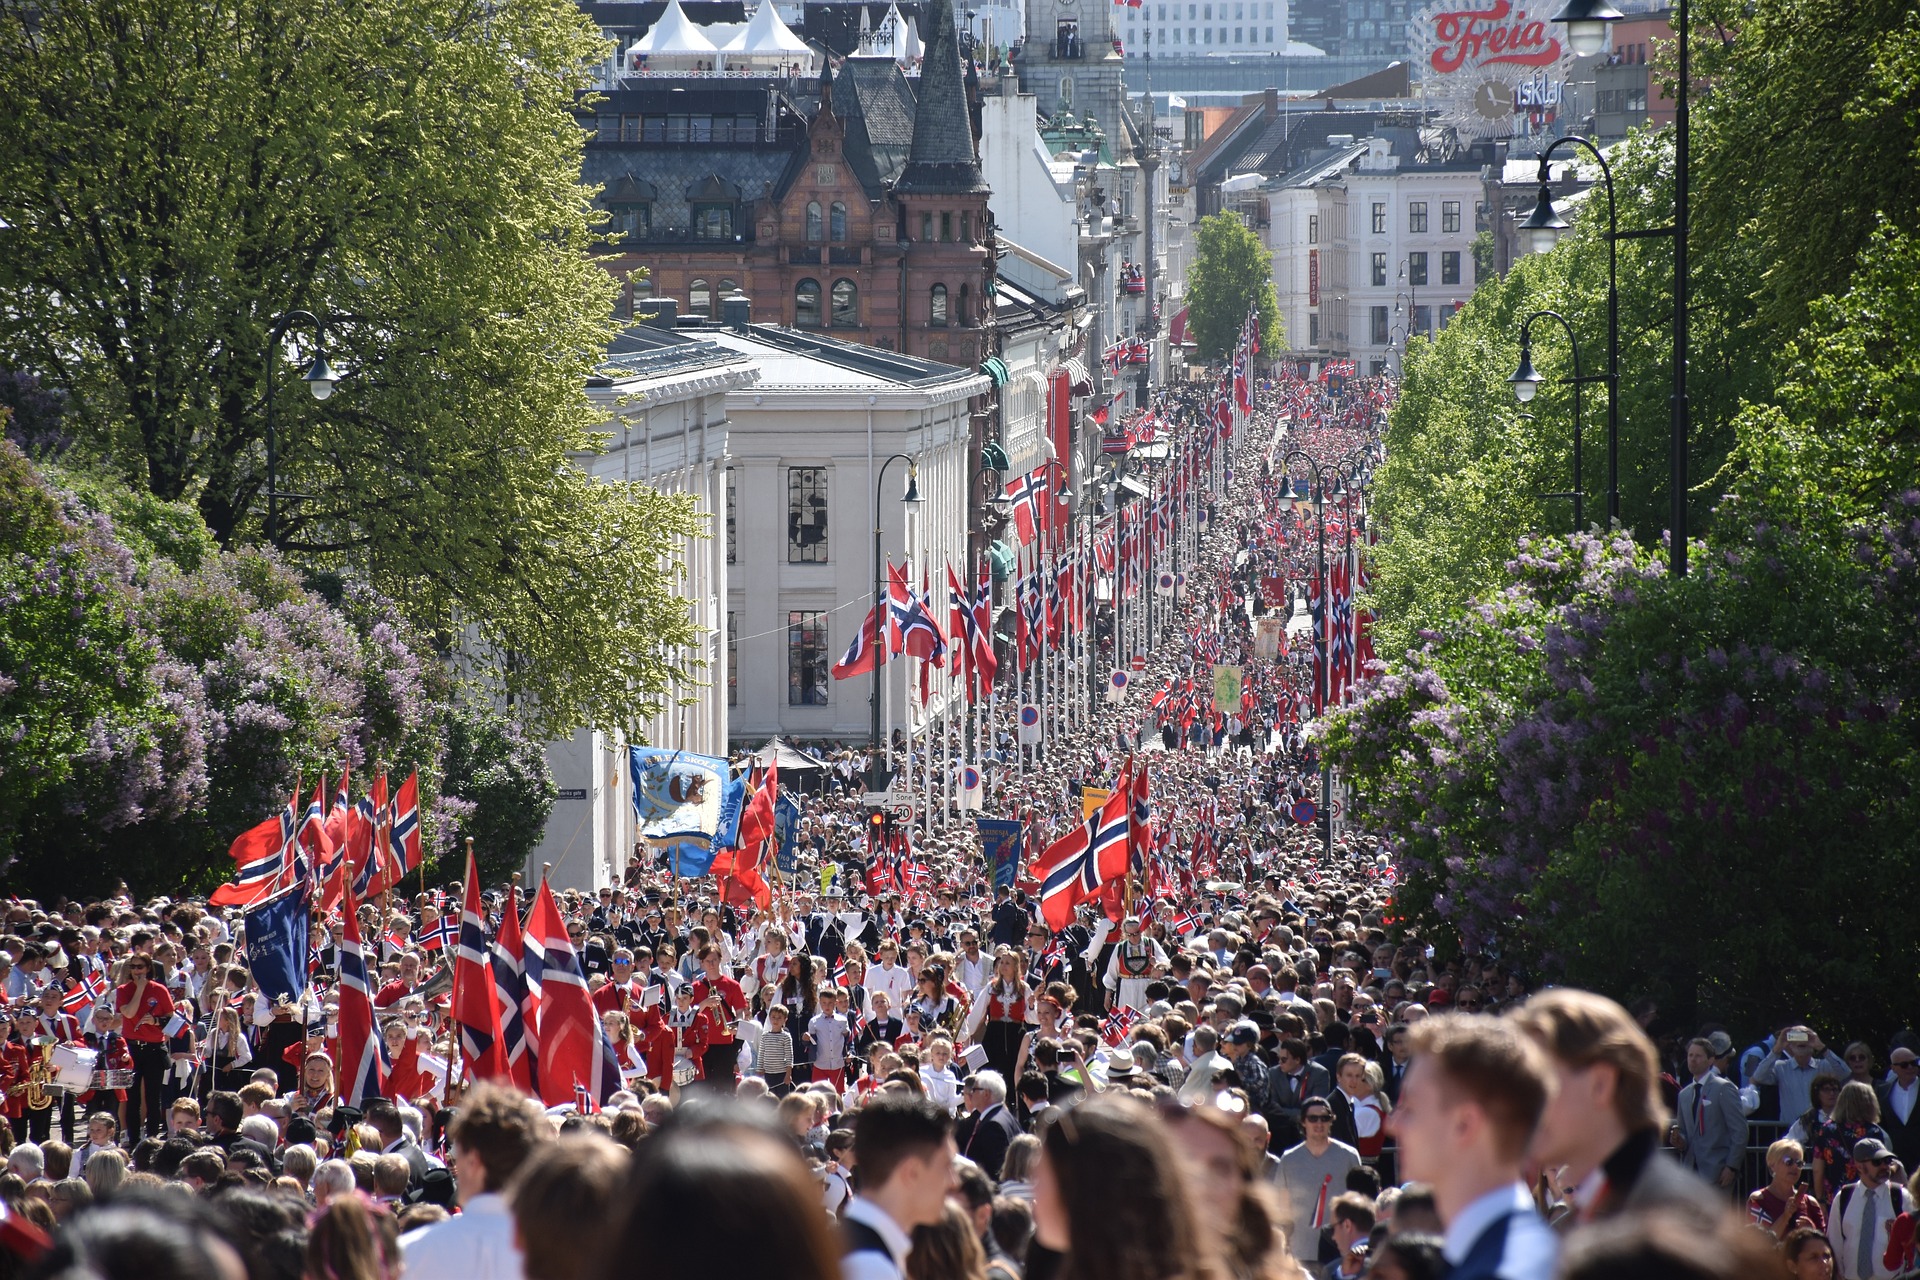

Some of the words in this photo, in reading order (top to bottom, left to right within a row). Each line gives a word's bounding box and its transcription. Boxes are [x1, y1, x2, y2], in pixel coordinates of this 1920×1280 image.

[1431, 0, 1561, 73] Freia
[683, 755, 720, 770] SKOLE
[895, 793, 913, 801] Sone
[898, 808, 910, 818] 30
